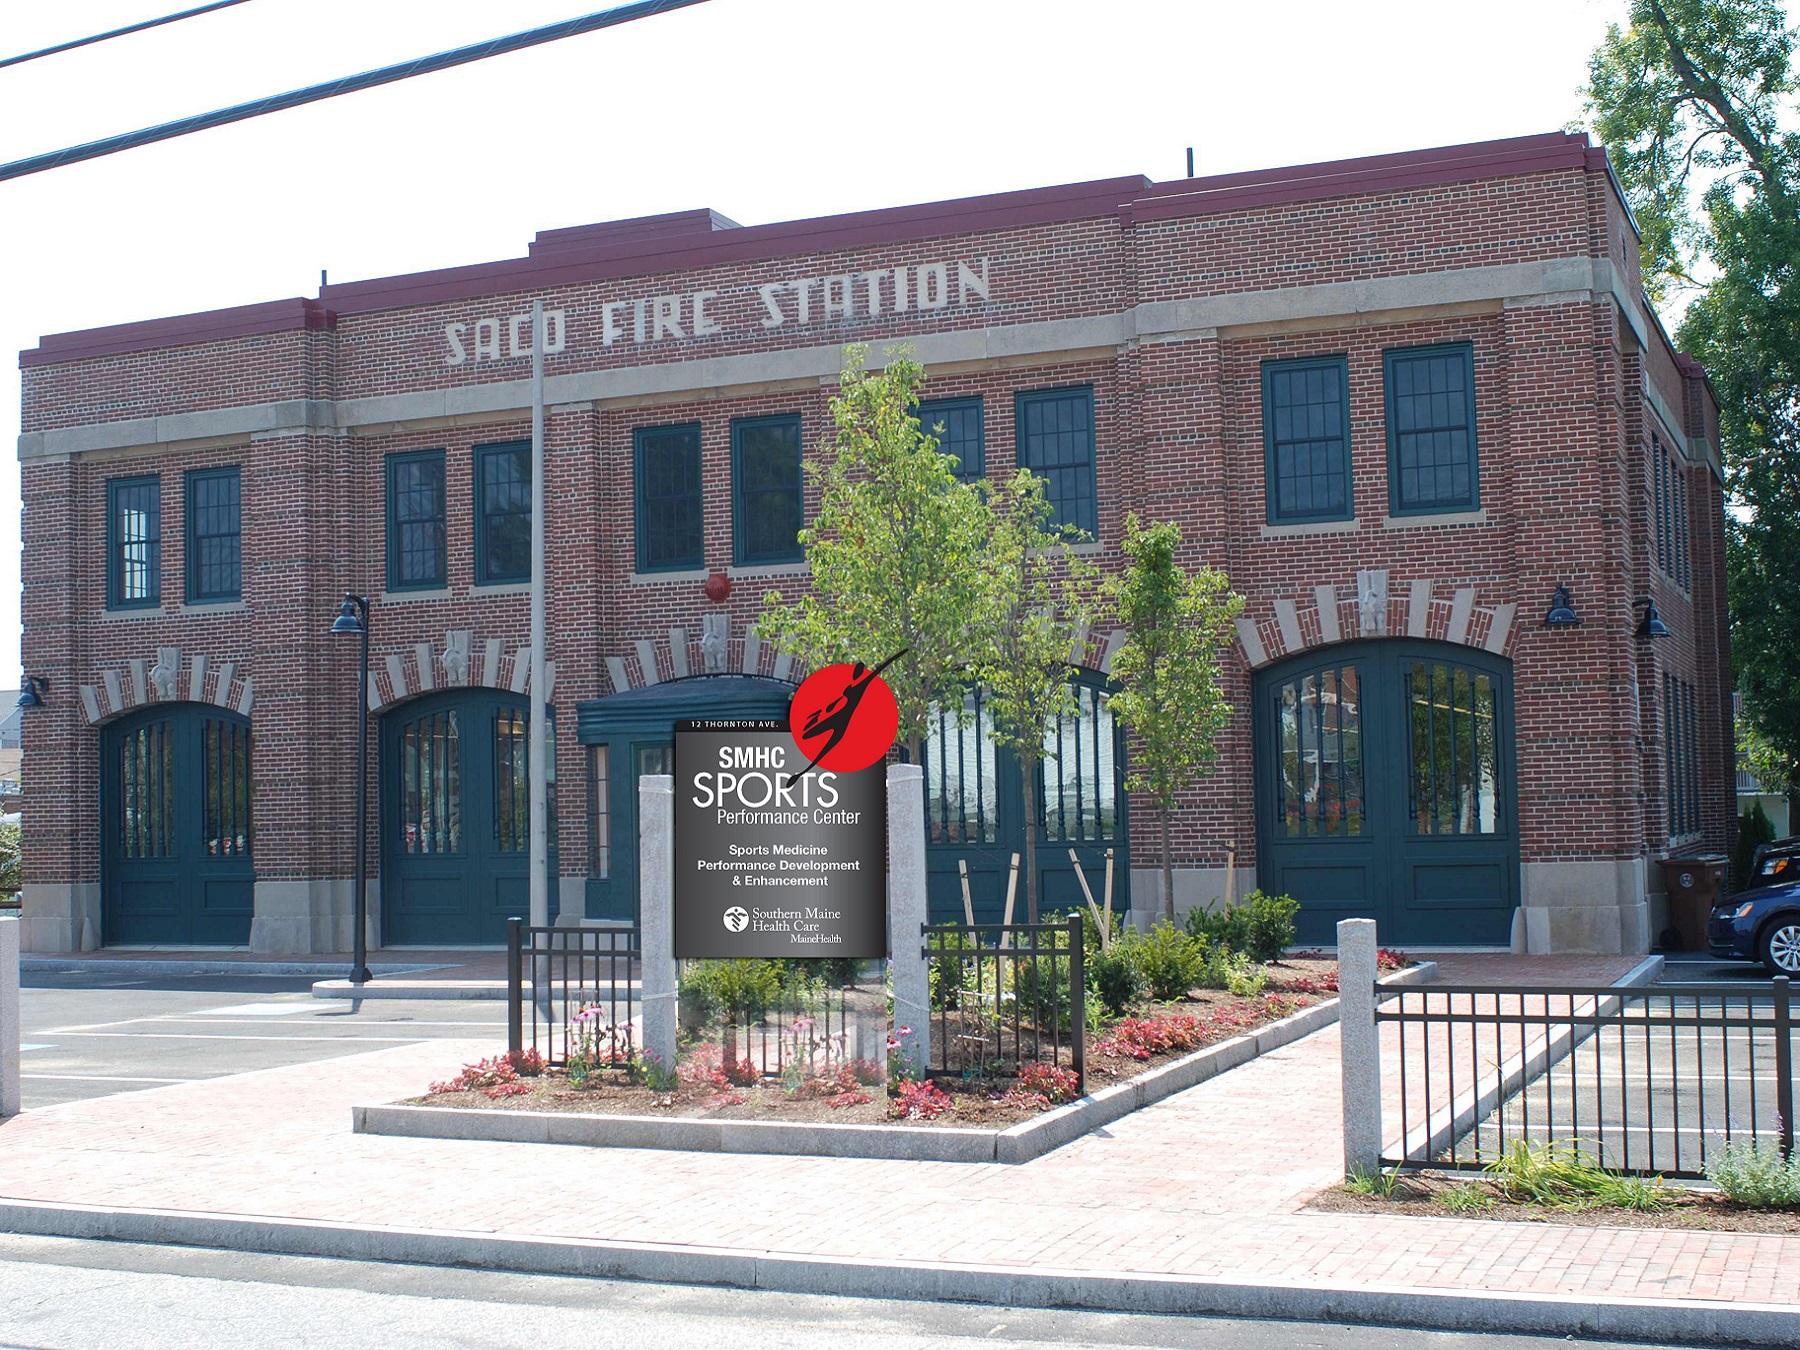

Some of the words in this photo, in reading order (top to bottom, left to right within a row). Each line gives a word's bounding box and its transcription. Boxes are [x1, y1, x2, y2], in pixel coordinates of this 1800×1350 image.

[445, 308, 566, 366] SACO
[602, 290, 721, 347] FIRE
[758, 256, 989, 329] STATION
[691, 720, 701, 728] 12
[704, 720, 755, 728] THORNTON
[758, 720, 779, 728] AVE.
[718, 746, 786, 769] SMHC
[692, 771, 839, 808] SPORTS
[717, 808, 809, 825] Performance
[813, 808, 861, 825] Center
[728, 844, 770, 858] Sports
[772, 844, 828, 856] Medicine
[697, 860, 777, 871] Performance
[779, 860, 860, 873] Development
[732, 875, 742, 886] &
[744, 876, 829, 887] Enhancement
[752, 907, 802, 920] Southern
[804, 907, 841, 920] Maine
[752, 919, 791, 932] Health
[793, 919, 820, 932] Care
[790, 933, 842, 944] MaineHealth
